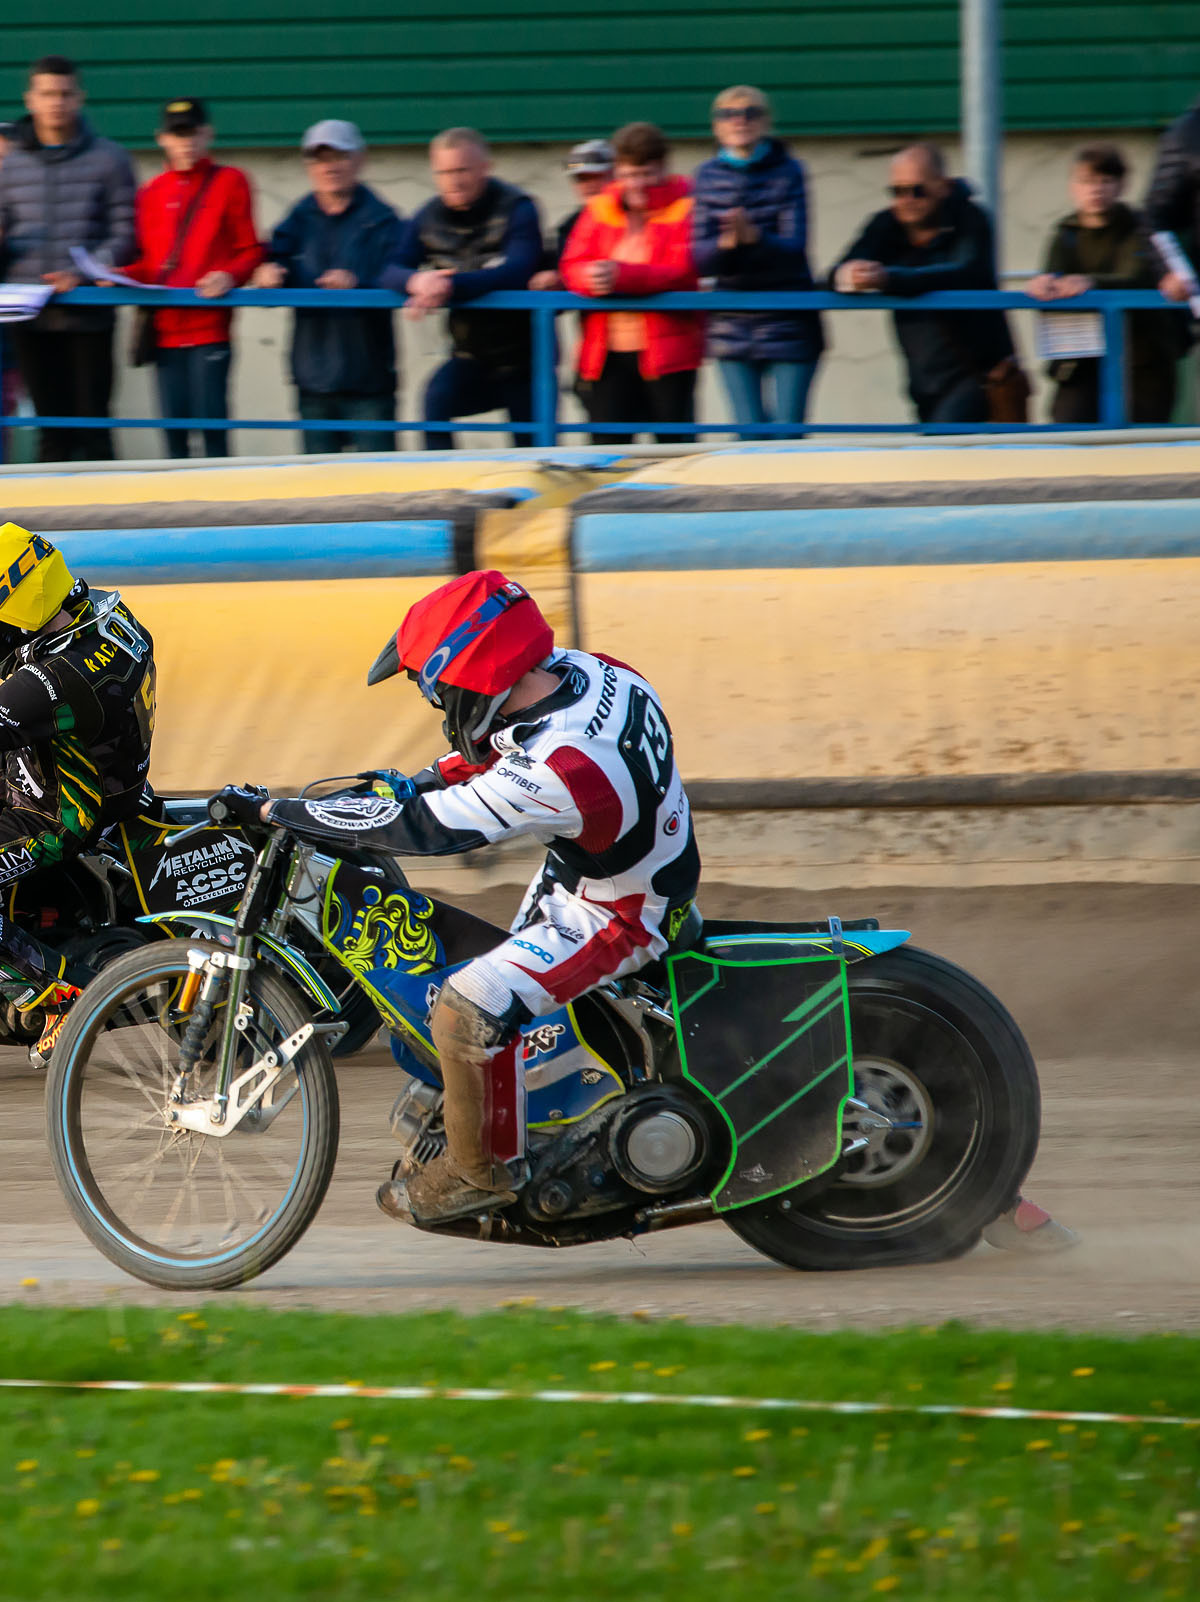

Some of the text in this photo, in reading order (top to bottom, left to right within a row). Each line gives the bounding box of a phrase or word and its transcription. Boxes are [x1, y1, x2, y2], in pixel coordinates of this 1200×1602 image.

[639, 698, 668, 785] 13
[497, 767, 542, 794] OPTIBET
[317, 803, 402, 828] SPEEDWAY MUSEUM
[148, 832, 255, 892] METALIKA
[173, 852, 235, 877] RECYCLING
[175, 861, 247, 901] ACDC
[192, 885, 236, 904] RECYCLING
